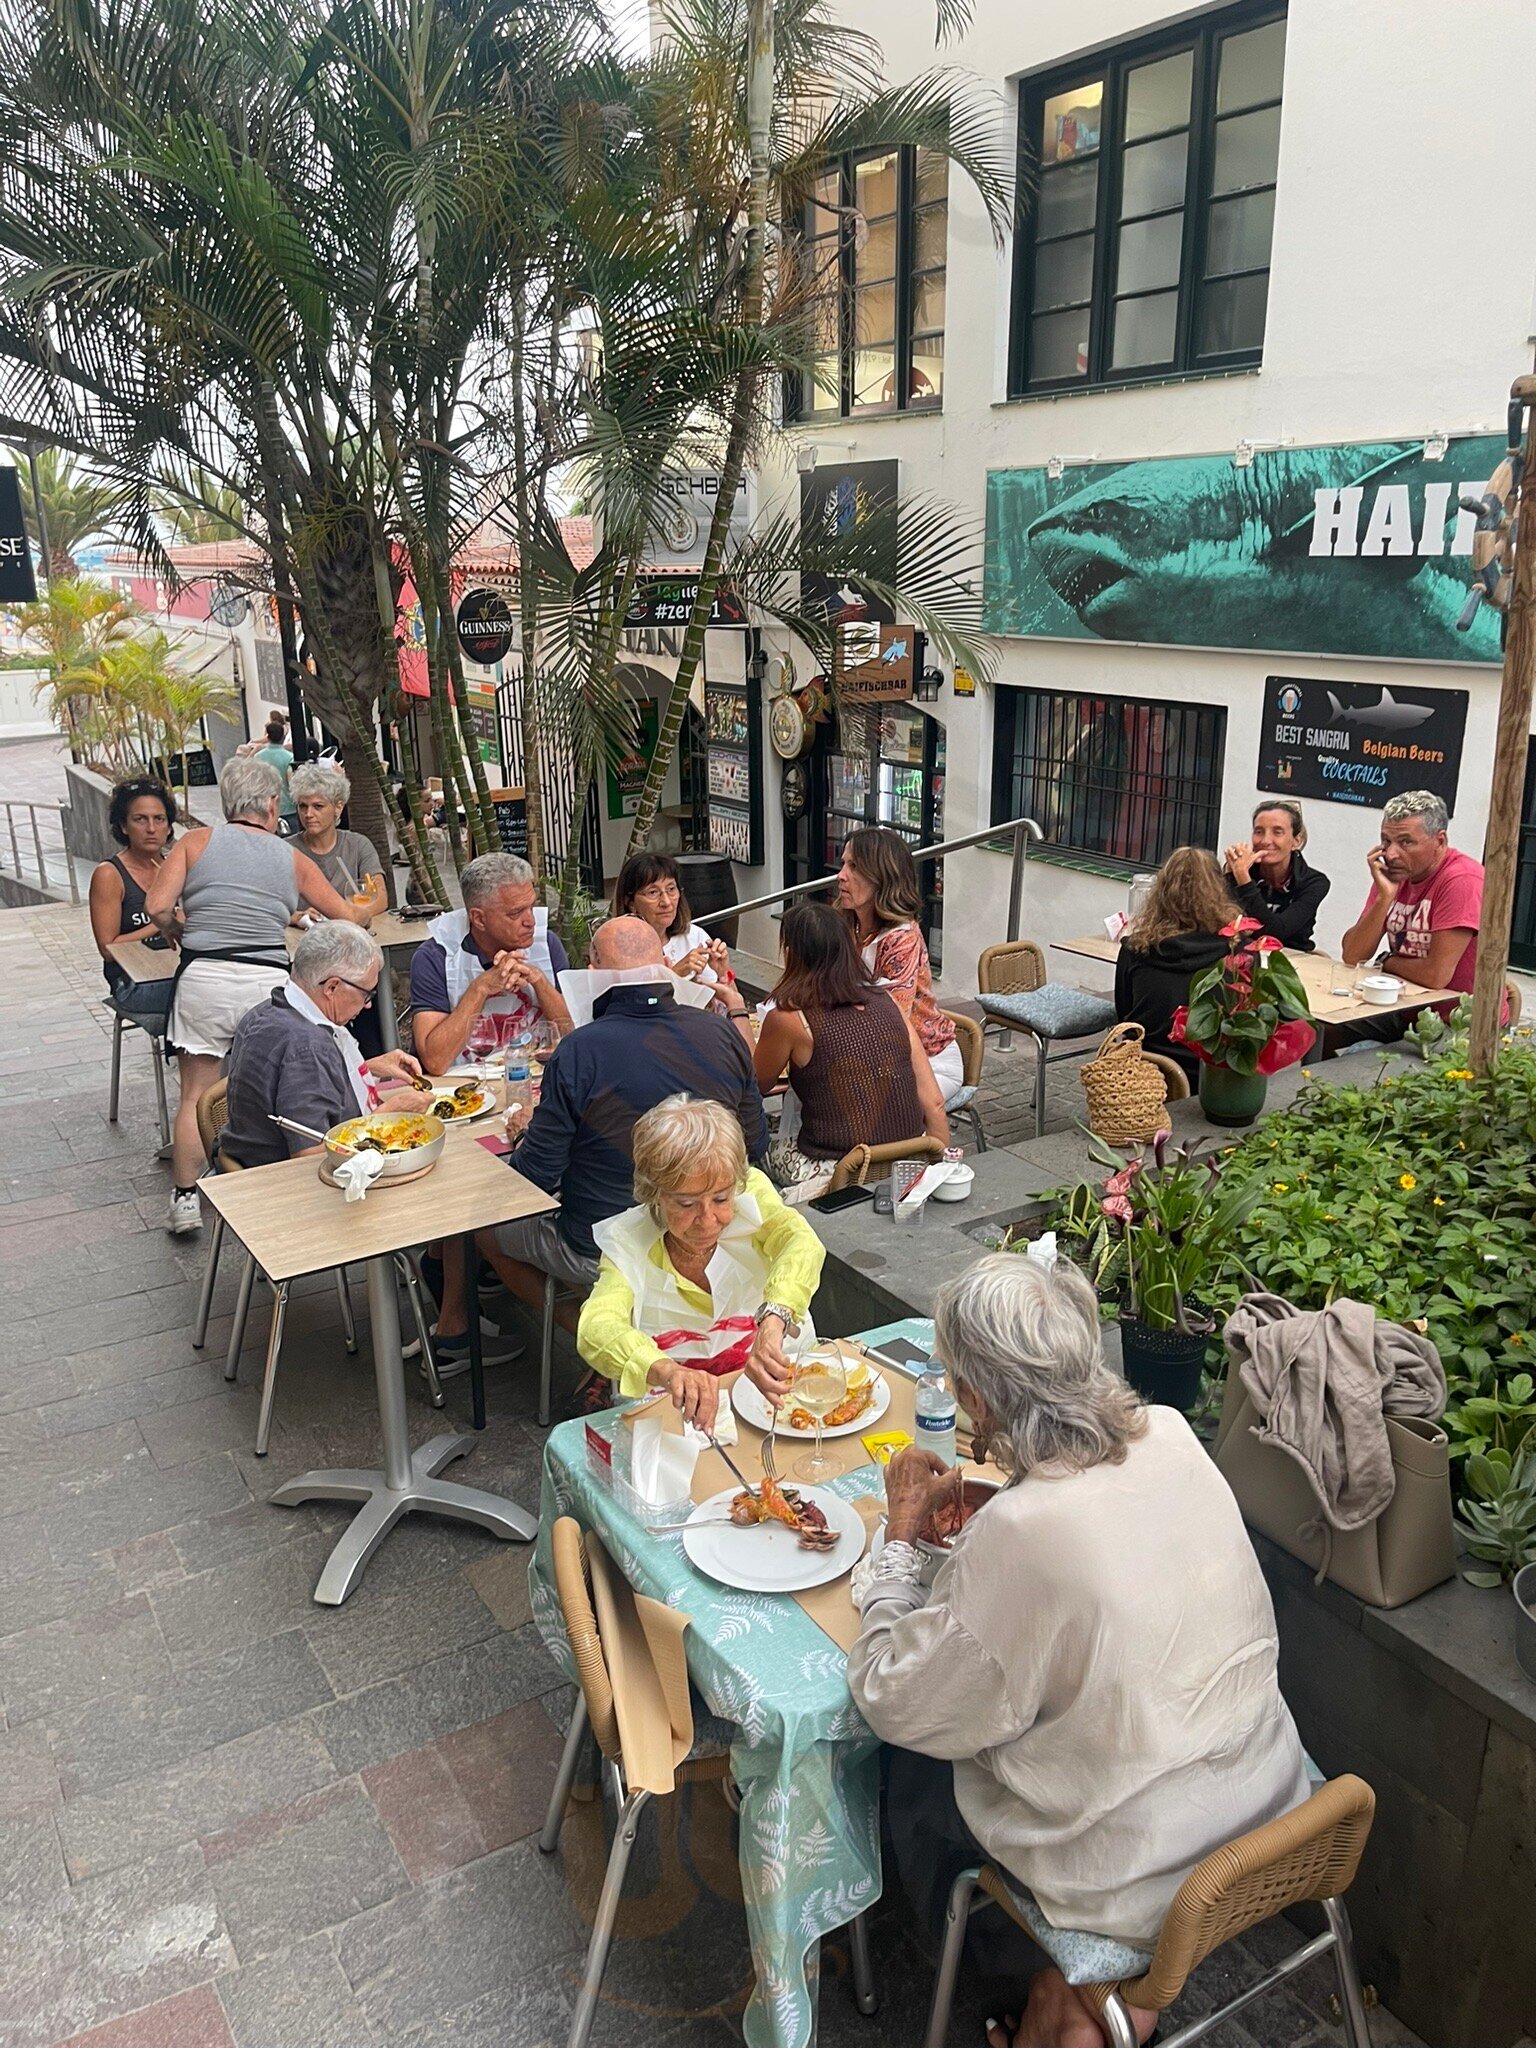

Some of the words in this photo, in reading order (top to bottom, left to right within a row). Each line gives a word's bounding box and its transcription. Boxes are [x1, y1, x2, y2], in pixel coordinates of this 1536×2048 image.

[655, 601, 721, 620] #zer1
[459, 620, 511, 635] GUINNESS
[1275, 724, 1304, 745] BEST
[1305, 727, 1350, 751] SANGRIA
[1316, 754, 1340, 765] Quality
[1362, 739, 1407, 761] Belgian
[1409, 744, 1444, 763] Beers
[1322, 762, 1389, 787] COCKTAILS
